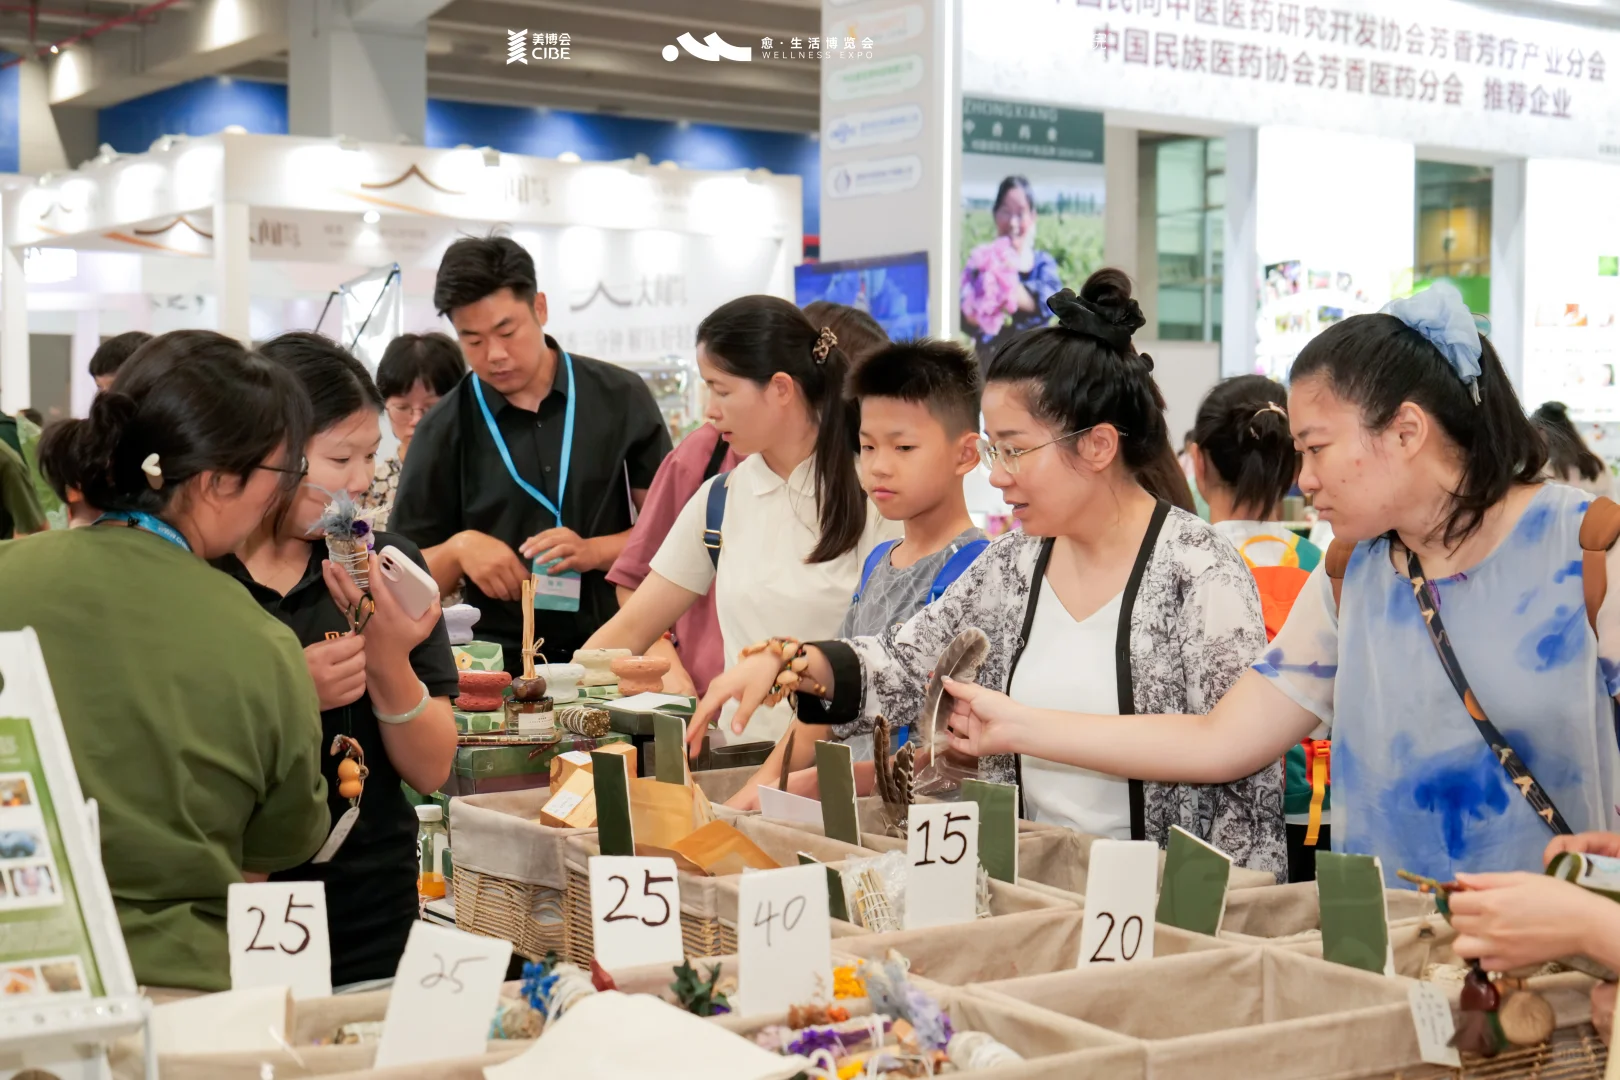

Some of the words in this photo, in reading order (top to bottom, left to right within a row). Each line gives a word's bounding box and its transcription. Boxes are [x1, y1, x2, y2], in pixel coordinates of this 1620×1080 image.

[1484, 77, 1572, 119] 推荐企业
[914, 812, 972, 865] 15
[245, 893, 314, 954] 25
[603, 869, 674, 927] 25
[753, 895, 807, 947] 40
[1089, 912, 1143, 963] 20
[420, 952, 488, 995] 25
